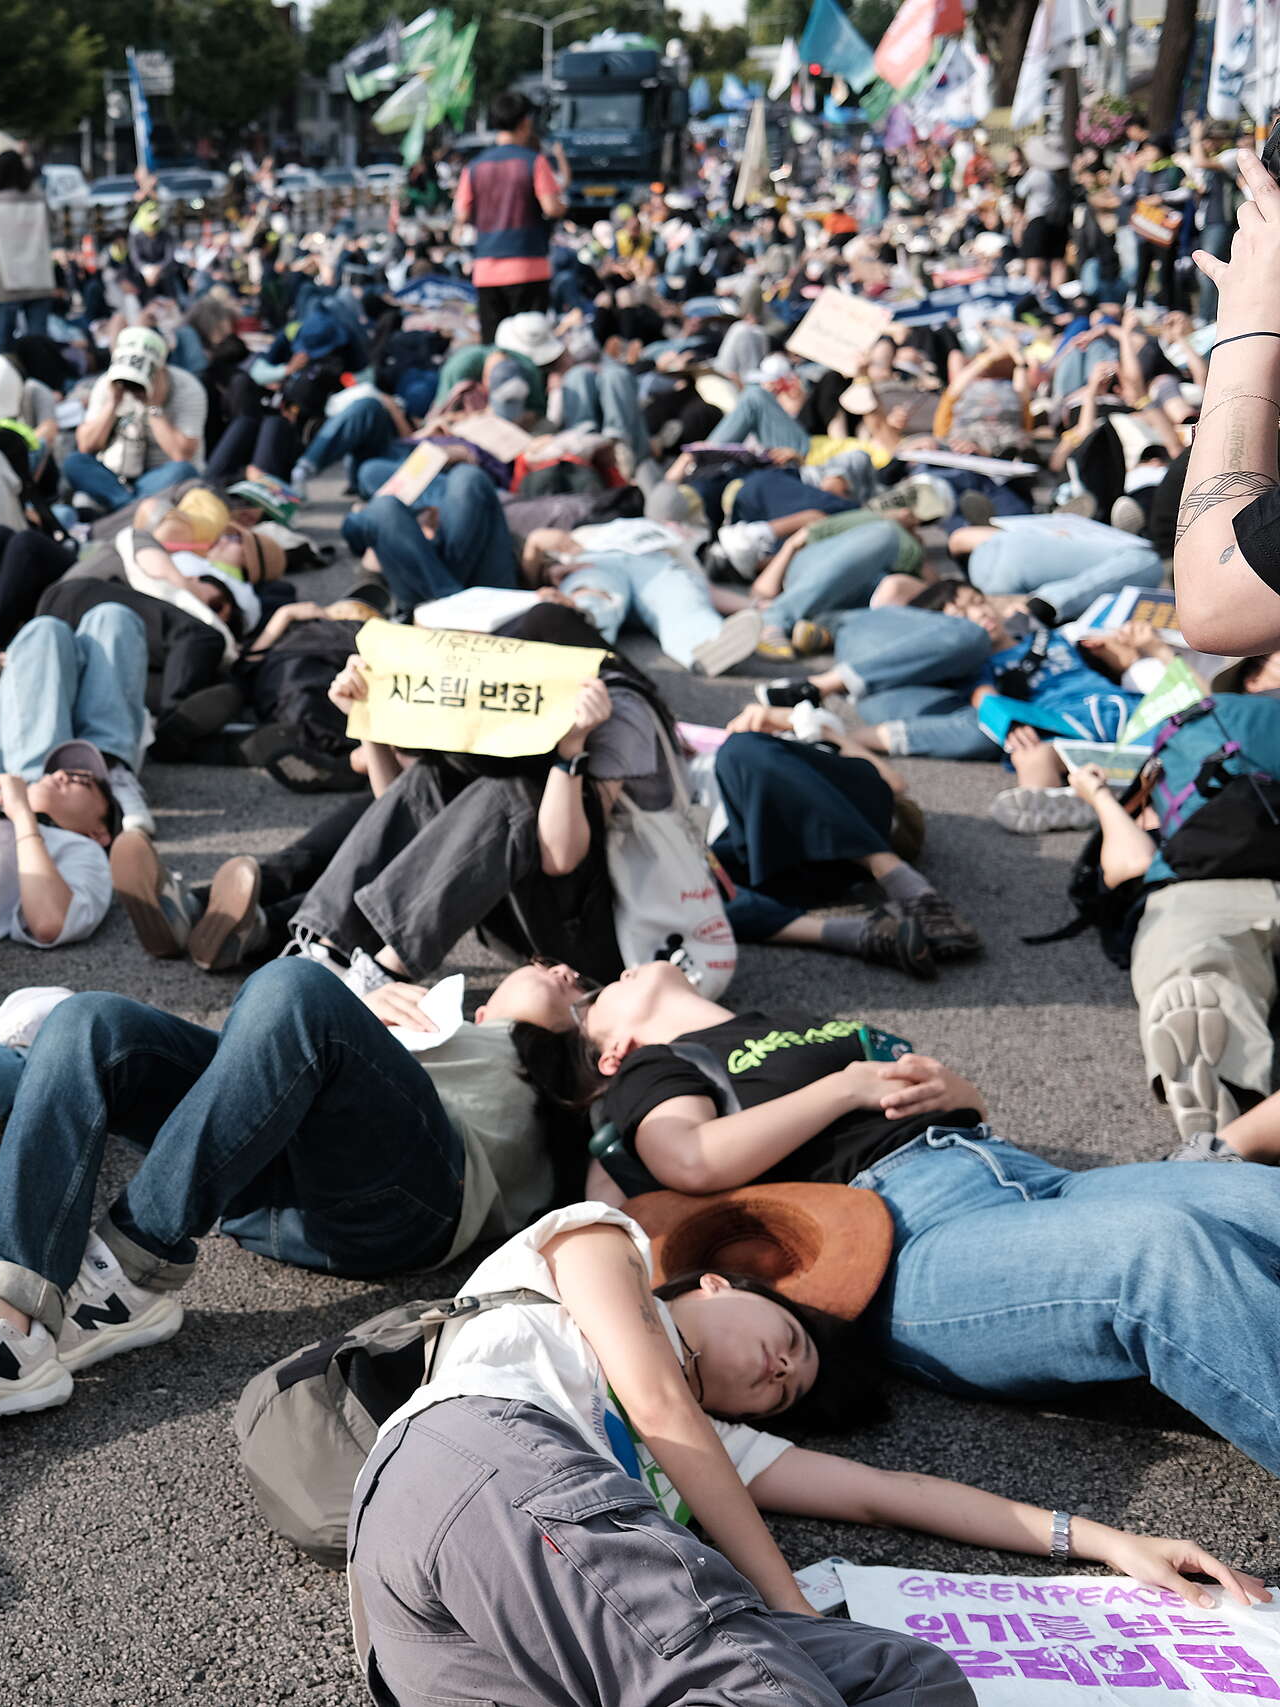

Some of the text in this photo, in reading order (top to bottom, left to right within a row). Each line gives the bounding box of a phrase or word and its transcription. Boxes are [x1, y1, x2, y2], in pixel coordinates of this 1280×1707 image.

[388, 673, 545, 716] 시스템 변화
[898, 1575, 1186, 1609] GREENPEACE
[904, 1612, 1236, 1645] 위기를 넘는
